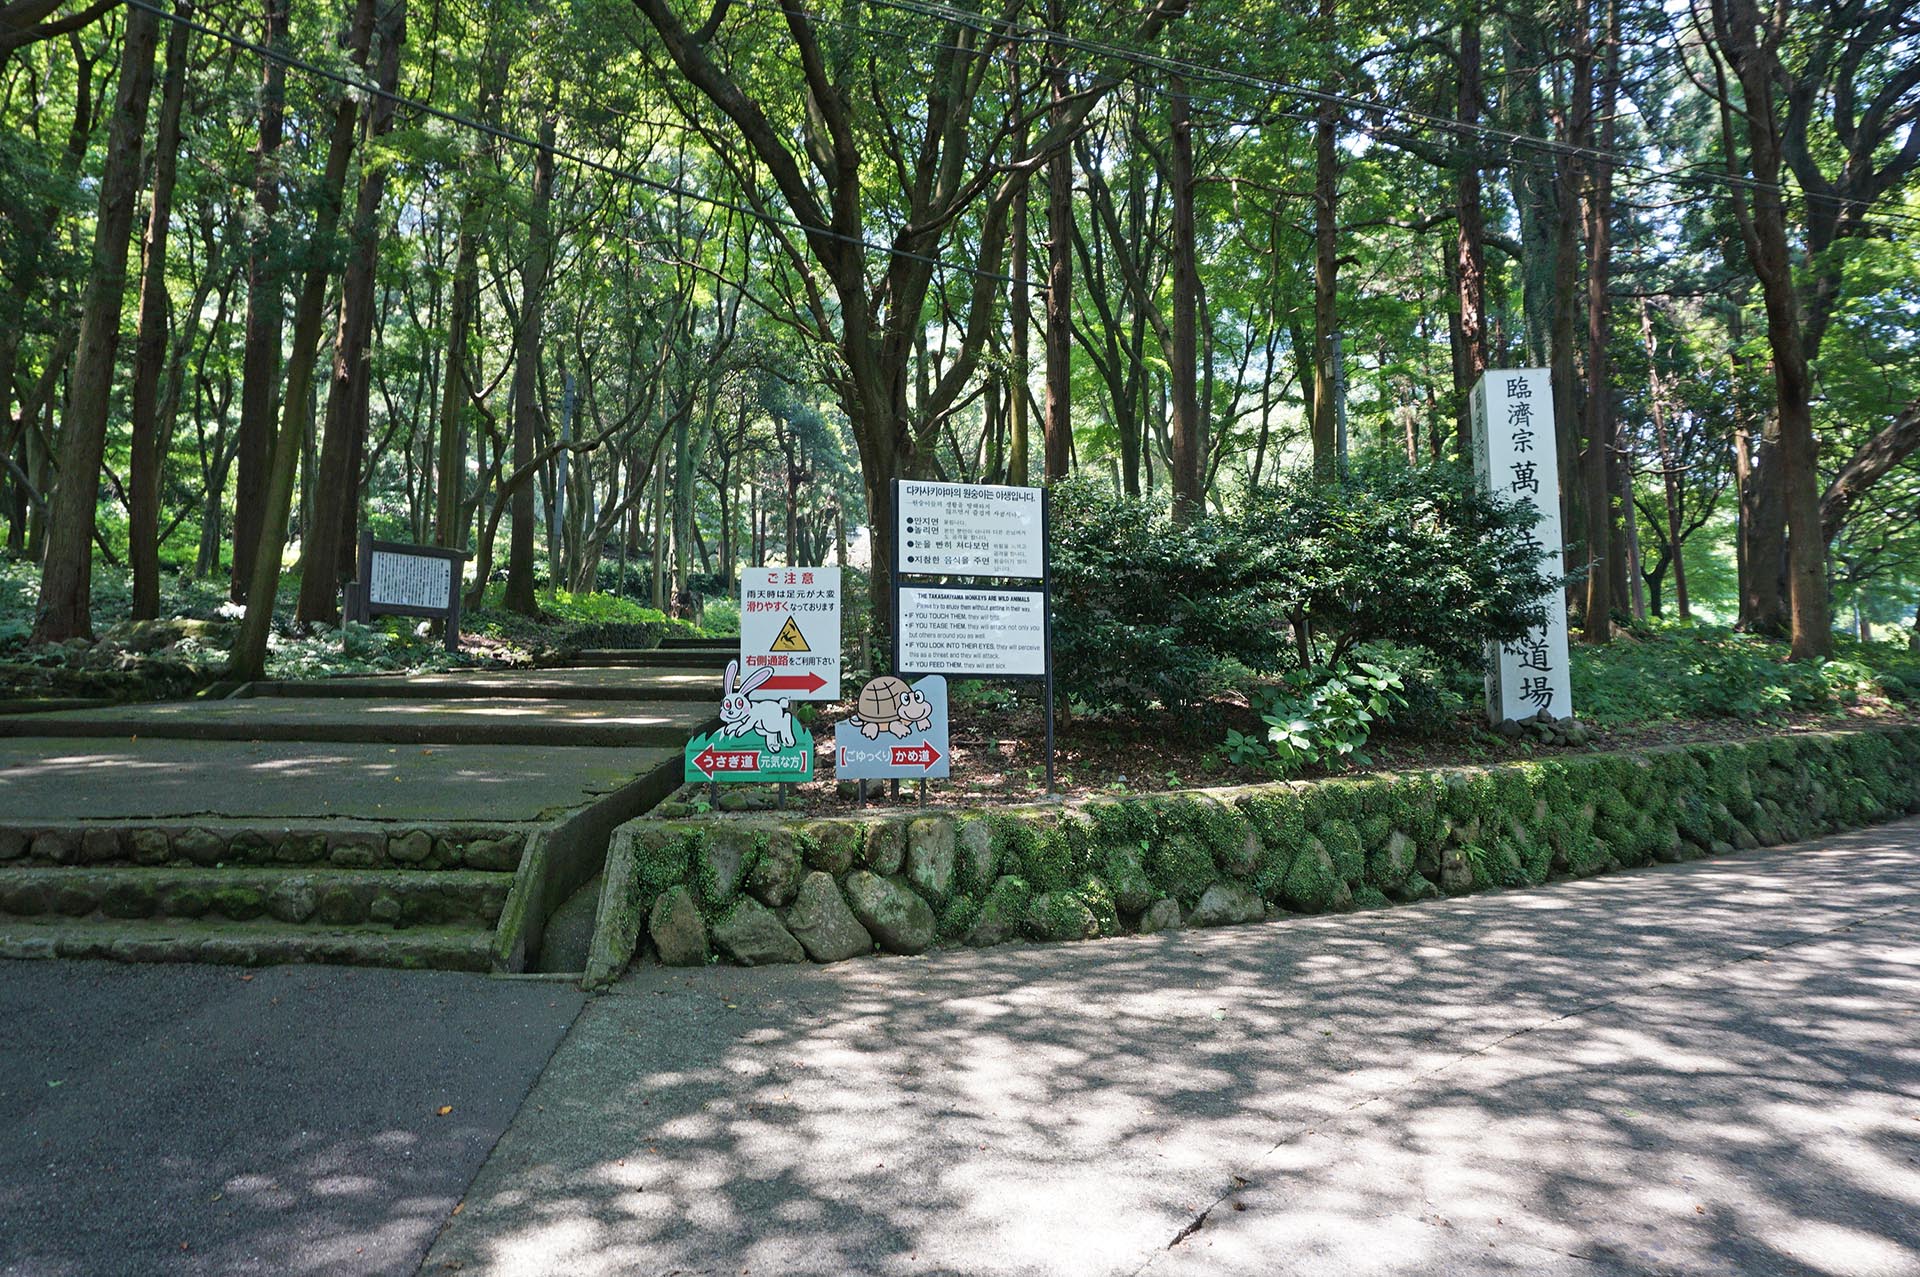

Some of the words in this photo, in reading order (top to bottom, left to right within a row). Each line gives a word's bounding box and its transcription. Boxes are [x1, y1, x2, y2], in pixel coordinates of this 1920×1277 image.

[906, 486, 961, 498] 다카사키야마의
[963, 489, 994, 500] 원숭이는
[996, 491, 1035, 502] 야생입니다.
[915, 526, 939, 535] 놀리면
[915, 540, 930, 549] 눈을
[915, 556, 939, 564] 지참한
[945, 556, 968, 564] 음식을
[974, 556, 990, 565] 주면
[768, 572, 814, 584] ご注意
[747, 590, 835, 599] 雨天時は足元が大変
[896, 749, 931, 762] かめ道
[703, 754, 754, 768] うさぎ道
